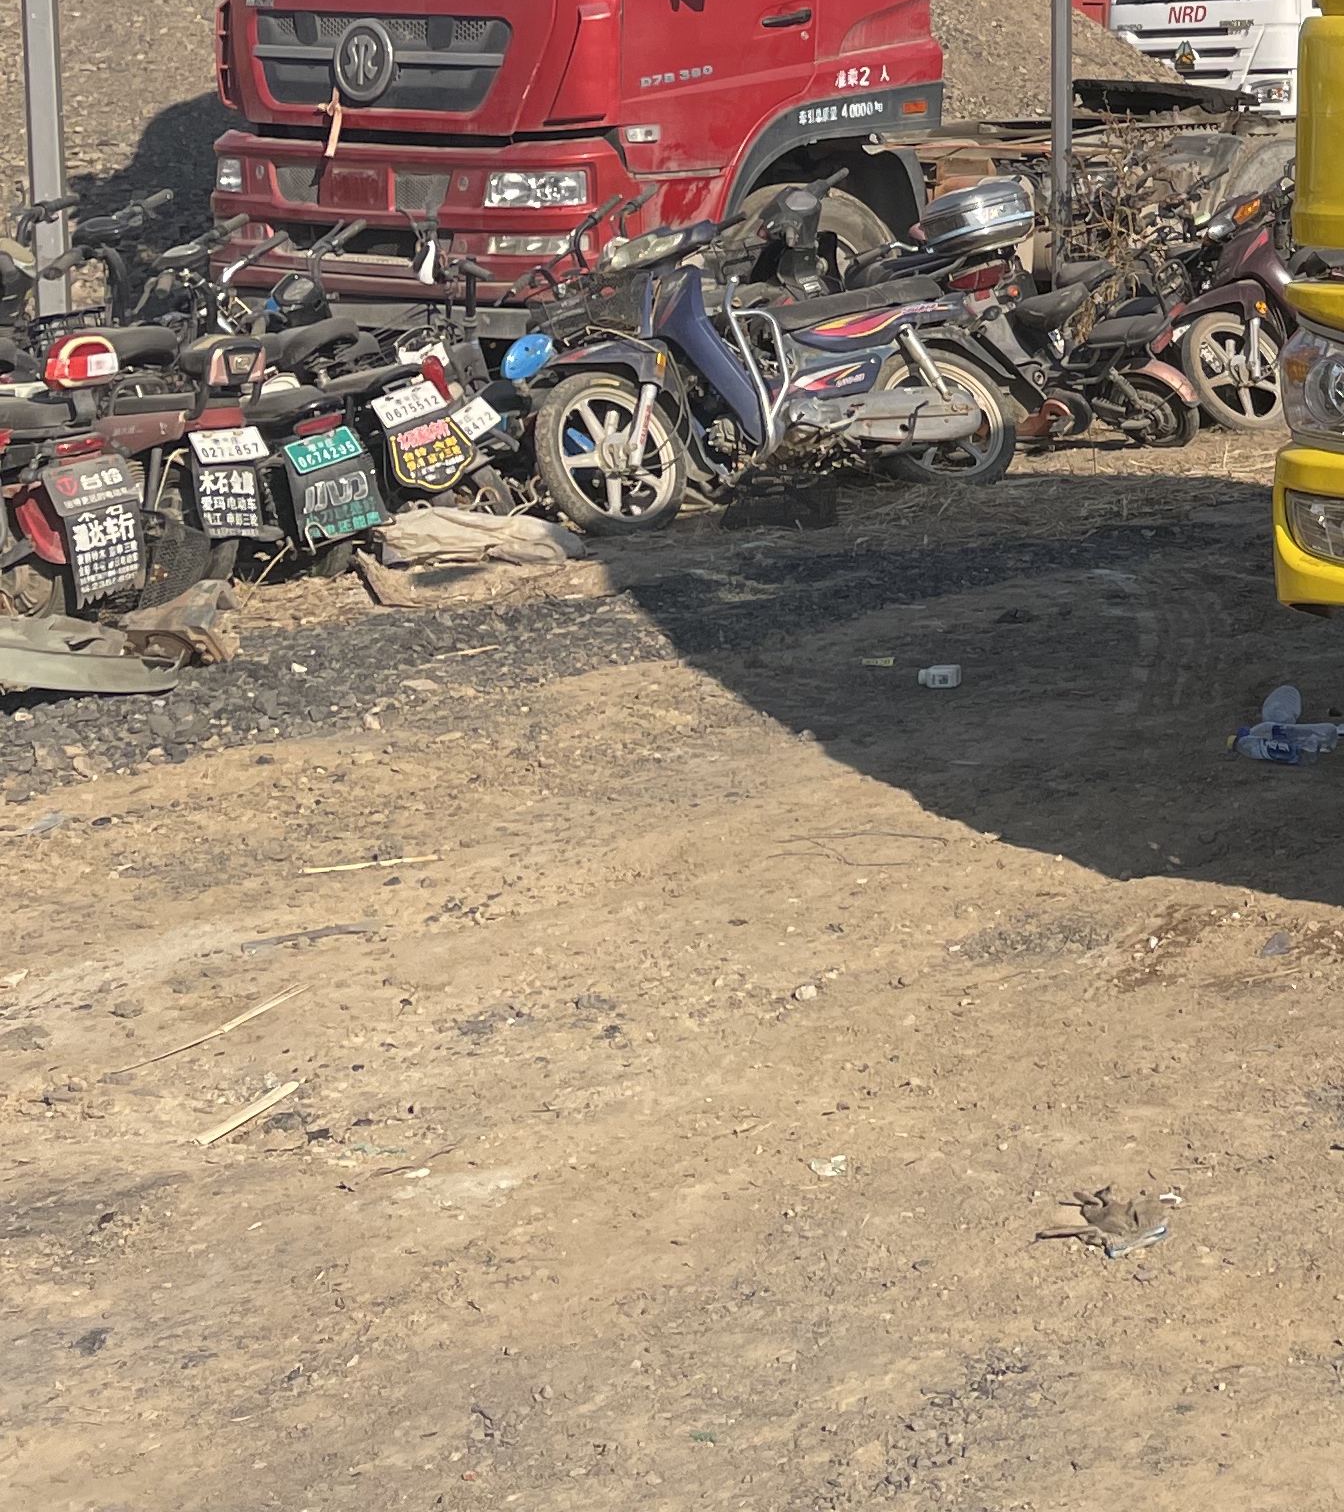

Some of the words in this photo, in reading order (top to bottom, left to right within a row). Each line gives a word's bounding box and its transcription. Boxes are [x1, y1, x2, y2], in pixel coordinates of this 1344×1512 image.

[1168, 5, 1207, 25] NRD
[879, 64, 890, 82] 人
[385, 394, 440, 422] 0675512
